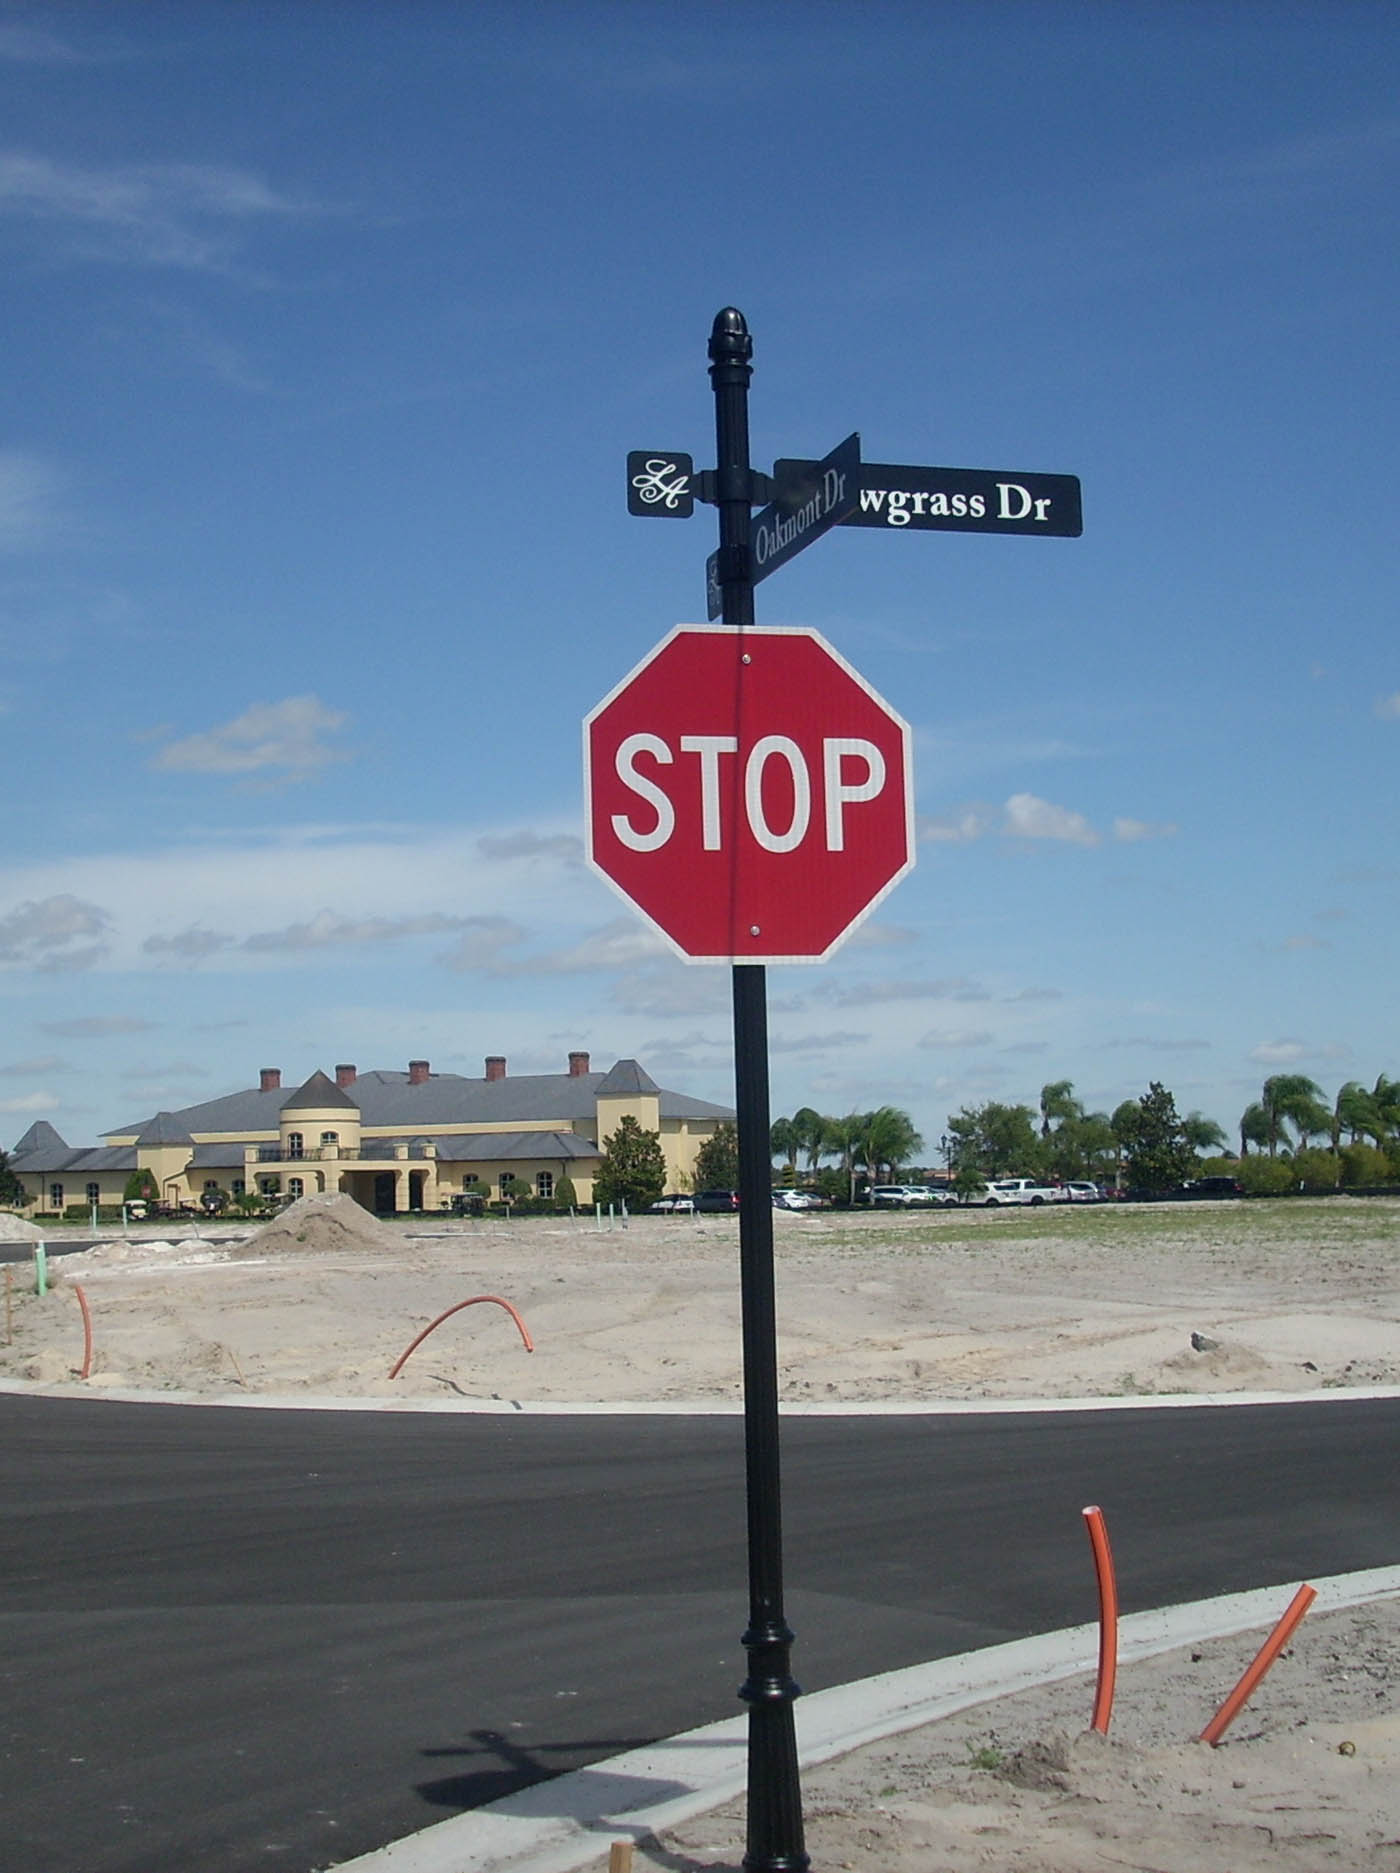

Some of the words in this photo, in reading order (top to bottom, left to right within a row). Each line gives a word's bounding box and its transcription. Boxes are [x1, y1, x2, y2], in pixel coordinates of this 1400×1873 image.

[756, 489, 822, 565] Oakmont
[823, 469, 846, 514] Dr
[996, 483, 1052, 521] Dr
[611, 733, 887, 854] STOP
